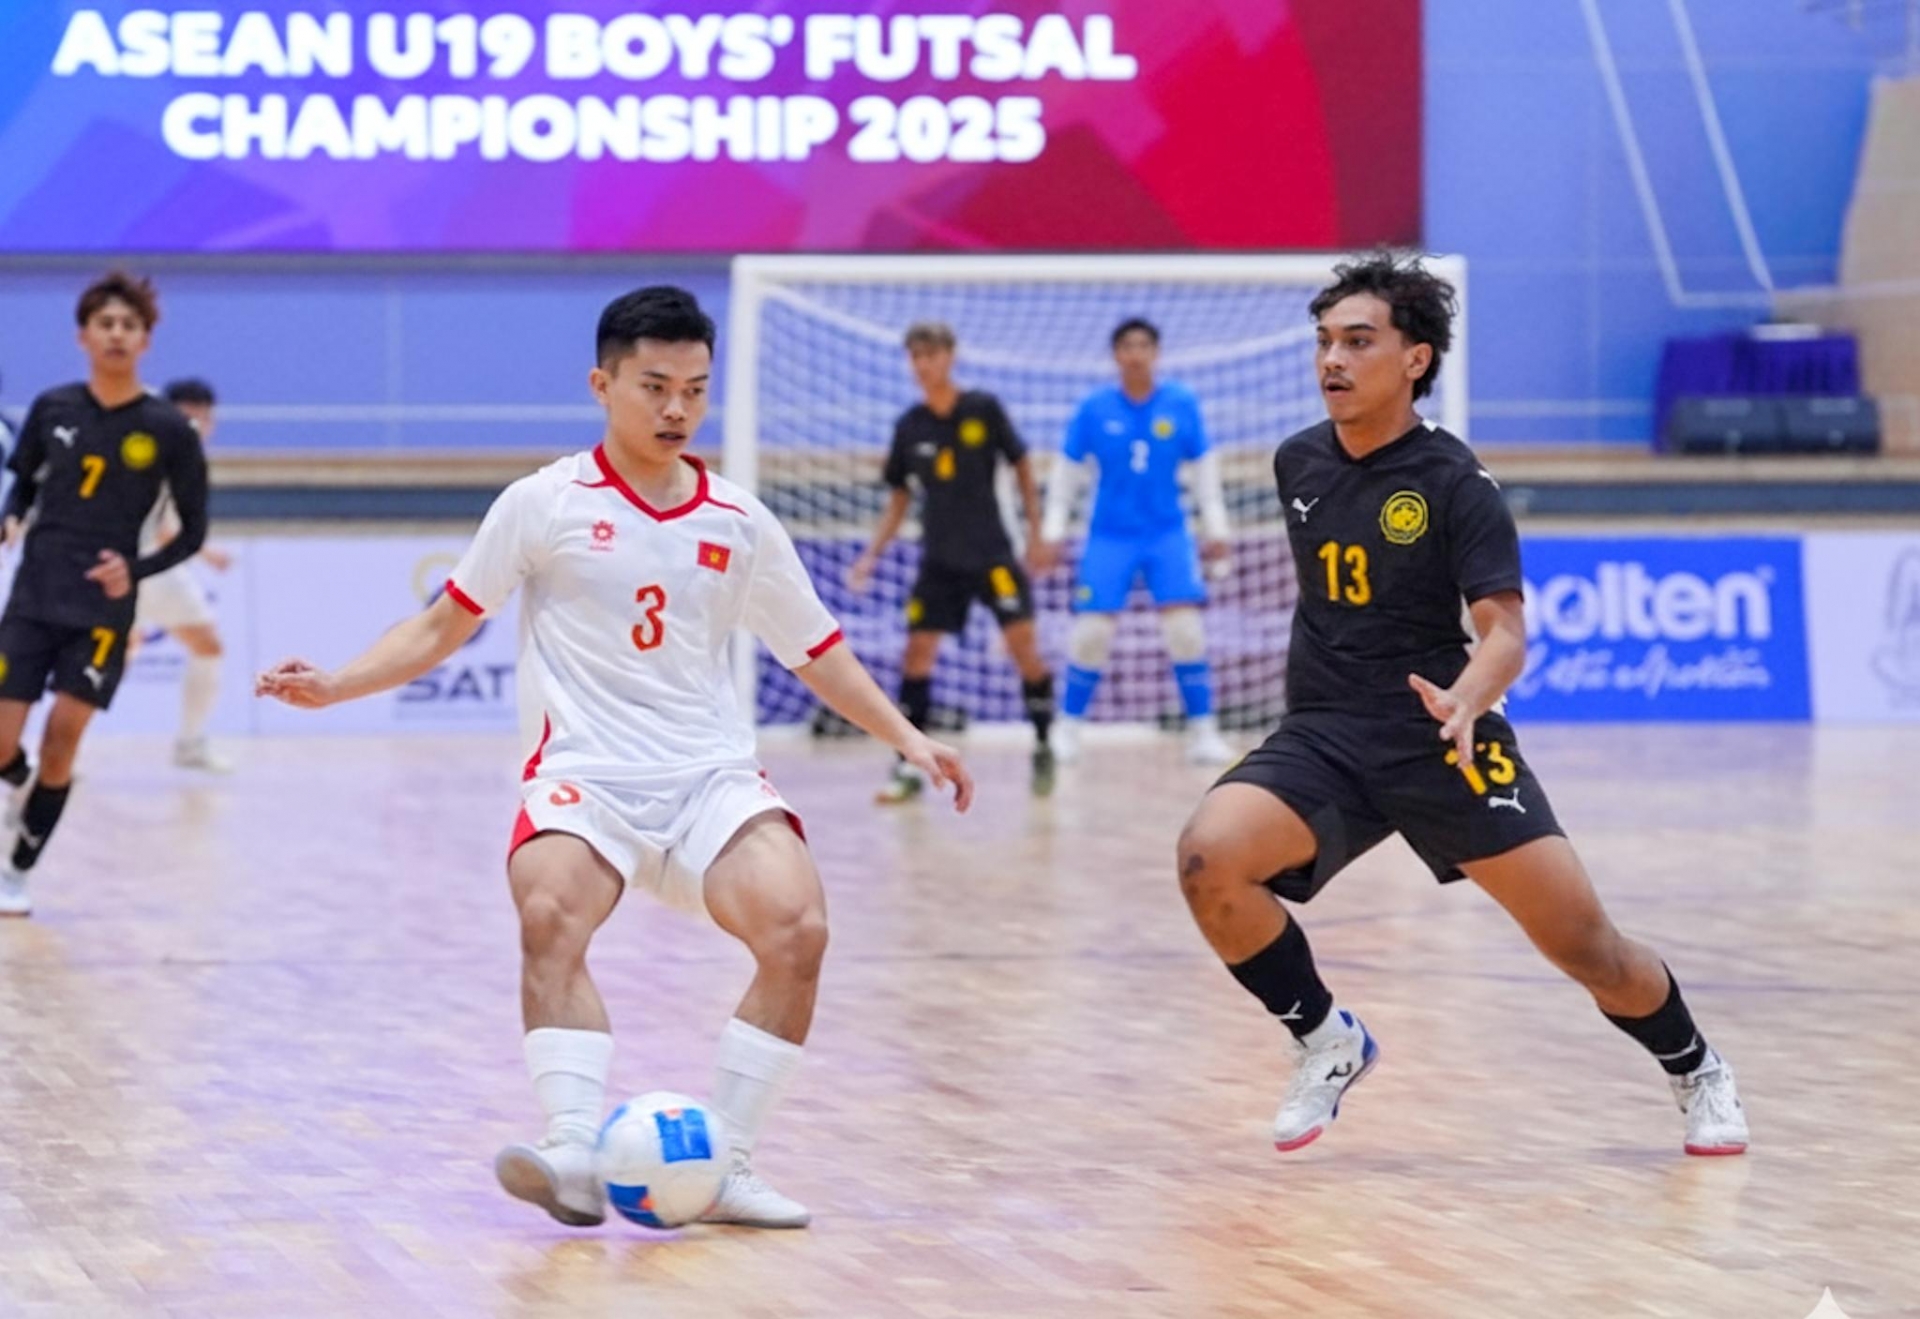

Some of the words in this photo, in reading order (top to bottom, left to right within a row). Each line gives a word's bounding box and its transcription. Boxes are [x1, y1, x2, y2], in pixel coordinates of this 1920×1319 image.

[51, 9, 353, 77] ASEAN
[366, 12, 536, 78] U19
[545, 12, 795, 80] BOYS'
[804, 13, 1138, 81] FUTSAL
[162, 92, 839, 162] CHAMPIONSHIP
[847, 95, 1046, 163] 2025
[79, 455, 106, 498] 7
[1318, 541, 1372, 606] 13
[92, 627, 116, 667] 7
[631, 584, 666, 652] 3
